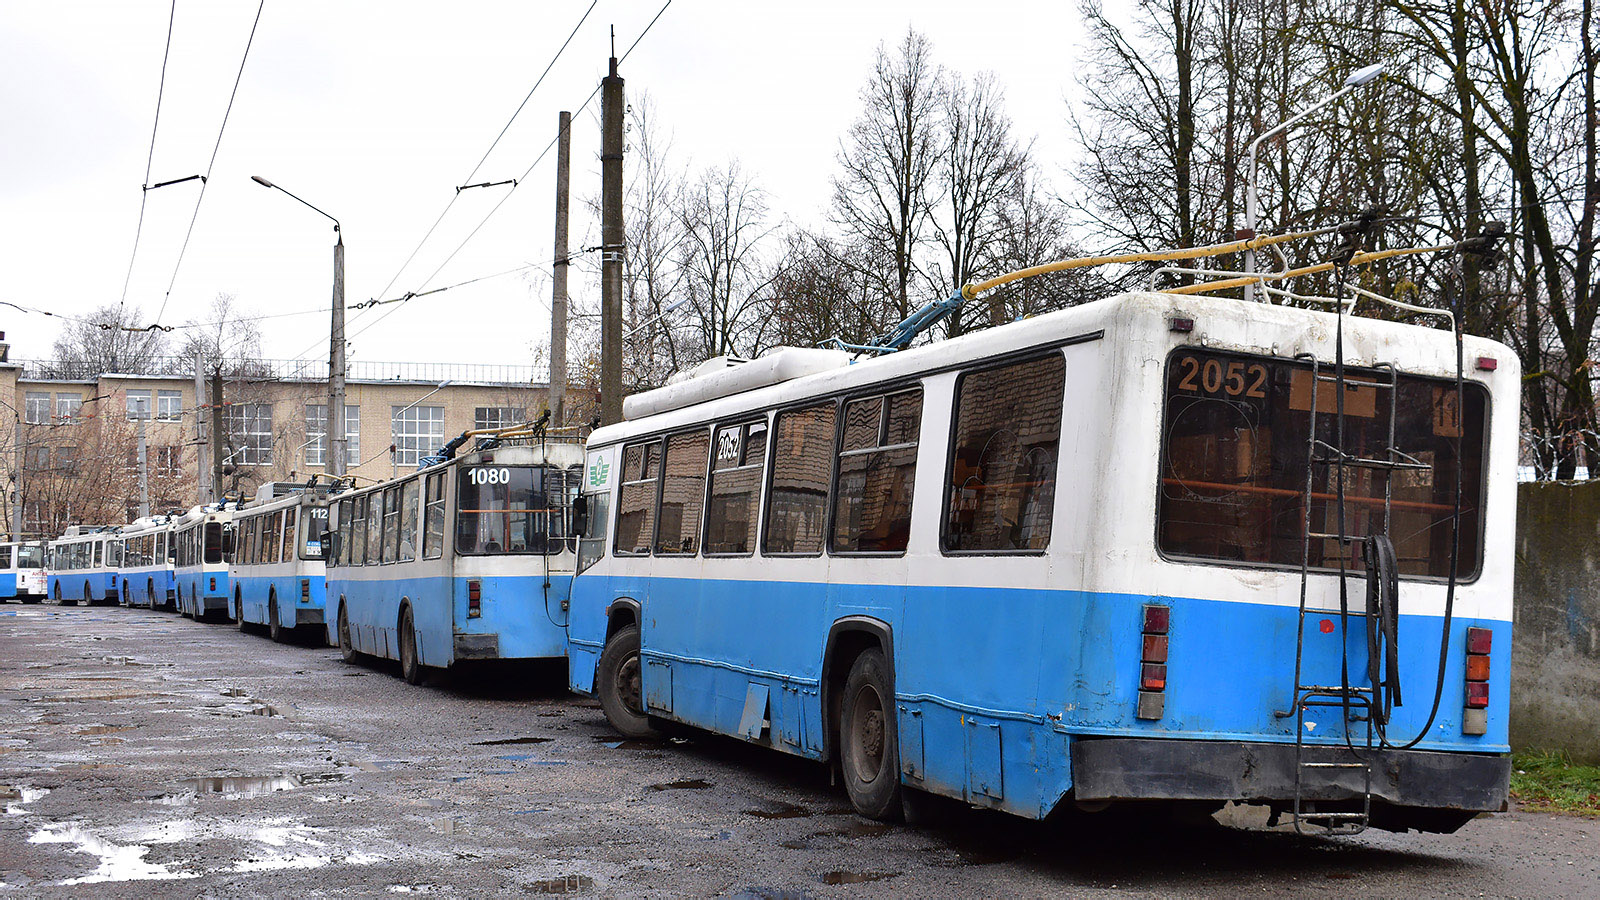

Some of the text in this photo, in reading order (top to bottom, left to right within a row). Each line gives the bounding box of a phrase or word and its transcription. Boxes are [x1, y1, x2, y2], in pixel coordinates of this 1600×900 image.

[1178, 356, 1266, 398] 2052
[718, 436, 739, 460] 2052
[468, 468, 510, 485] 1080
[310, 508, 328, 519] 112
